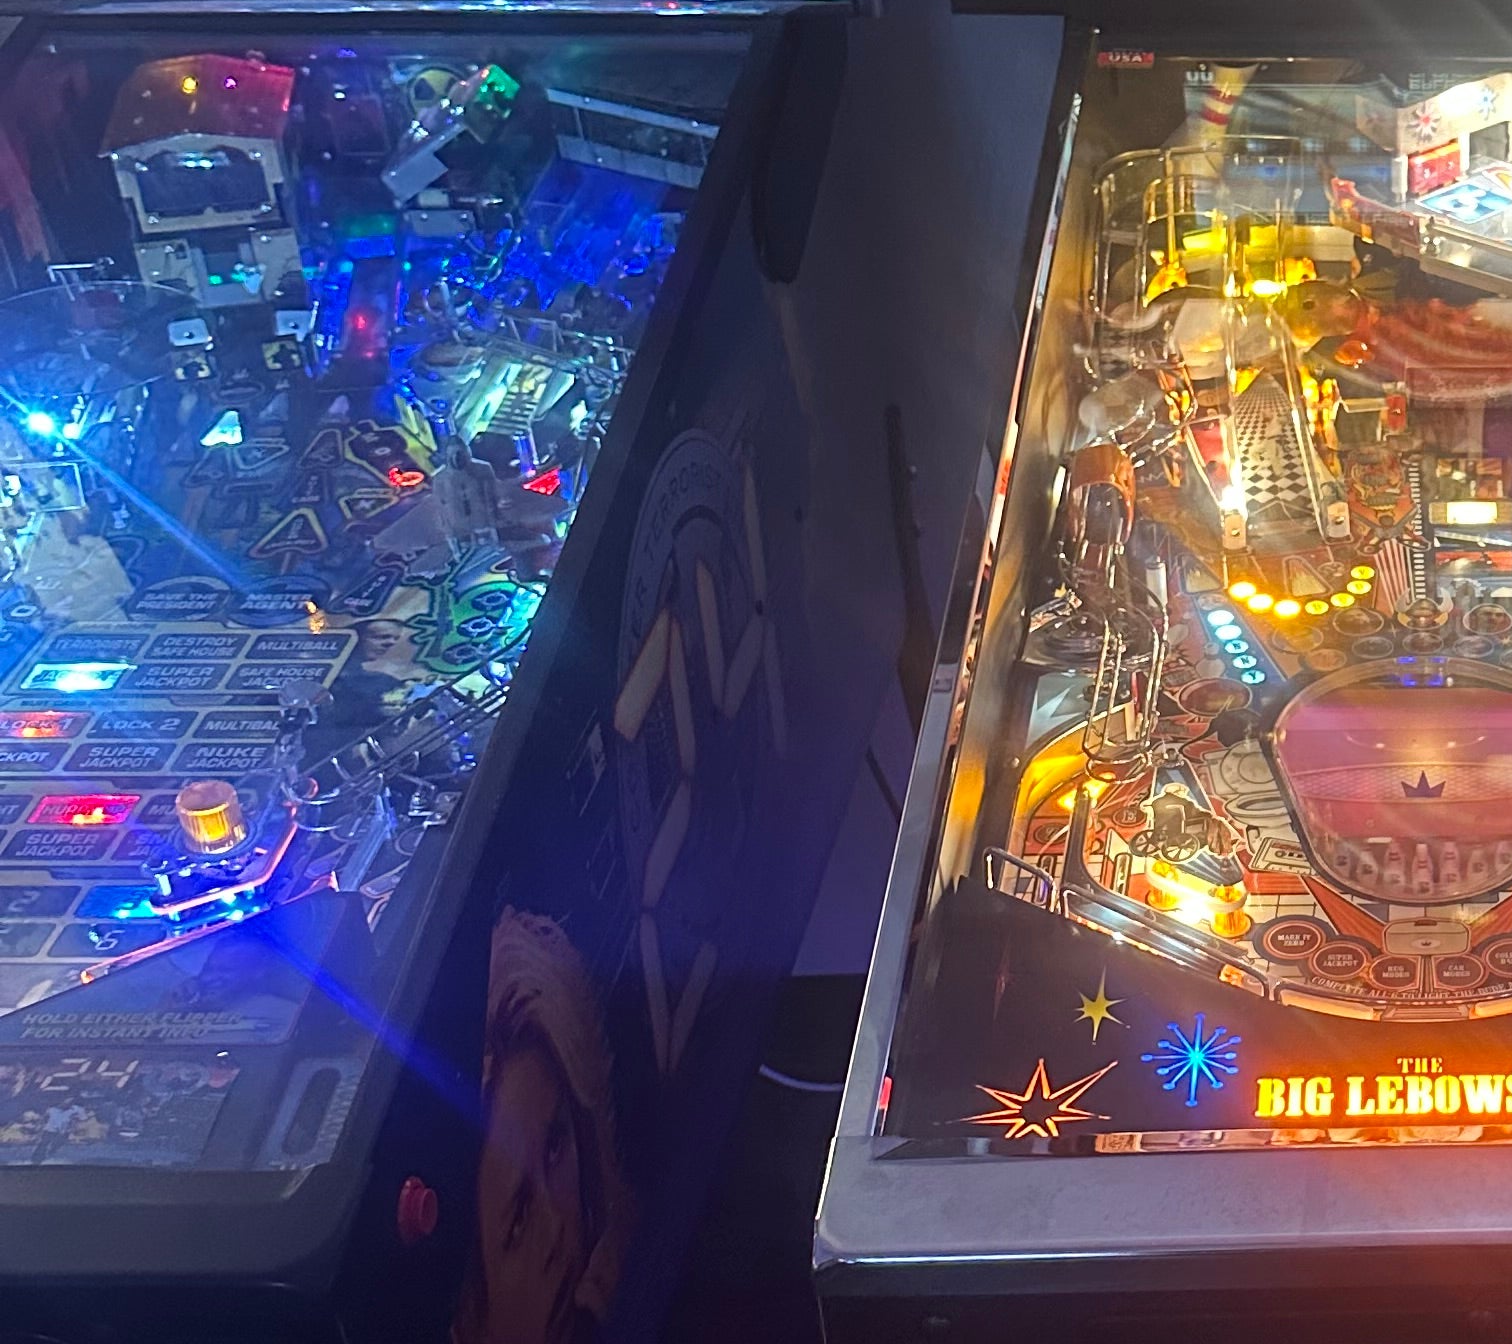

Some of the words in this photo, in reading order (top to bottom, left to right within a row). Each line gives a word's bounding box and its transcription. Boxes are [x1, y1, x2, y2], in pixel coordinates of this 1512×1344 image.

[248, 592, 313, 602] MASTER
[135, 600, 216, 610] PRESIDENT
[163, 636, 238, 648] DESTROY
[257, 640, 339, 651] MULTIBALL
[148, 666, 216, 677] SUPER
[135, 676, 213, 688] JACKPOT
[102, 719, 152, 730] LOCK
[159, 717, 182, 731] 2
[89, 746, 160, 757] SUPER
[198, 746, 267, 757] NUKE
[79, 757, 152, 768] JACKPOT
[186, 757, 260, 769] JACKPOT
[26, 834, 99, 844] SUPER
[15, 844, 96, 856] JACKPOT
[21, 1013, 78, 1025] HOLD
[20, 1026, 62, 1039] FOR
[1397, 1057, 1443, 1074] THE
[1254, 1076, 1335, 1117] BIG
